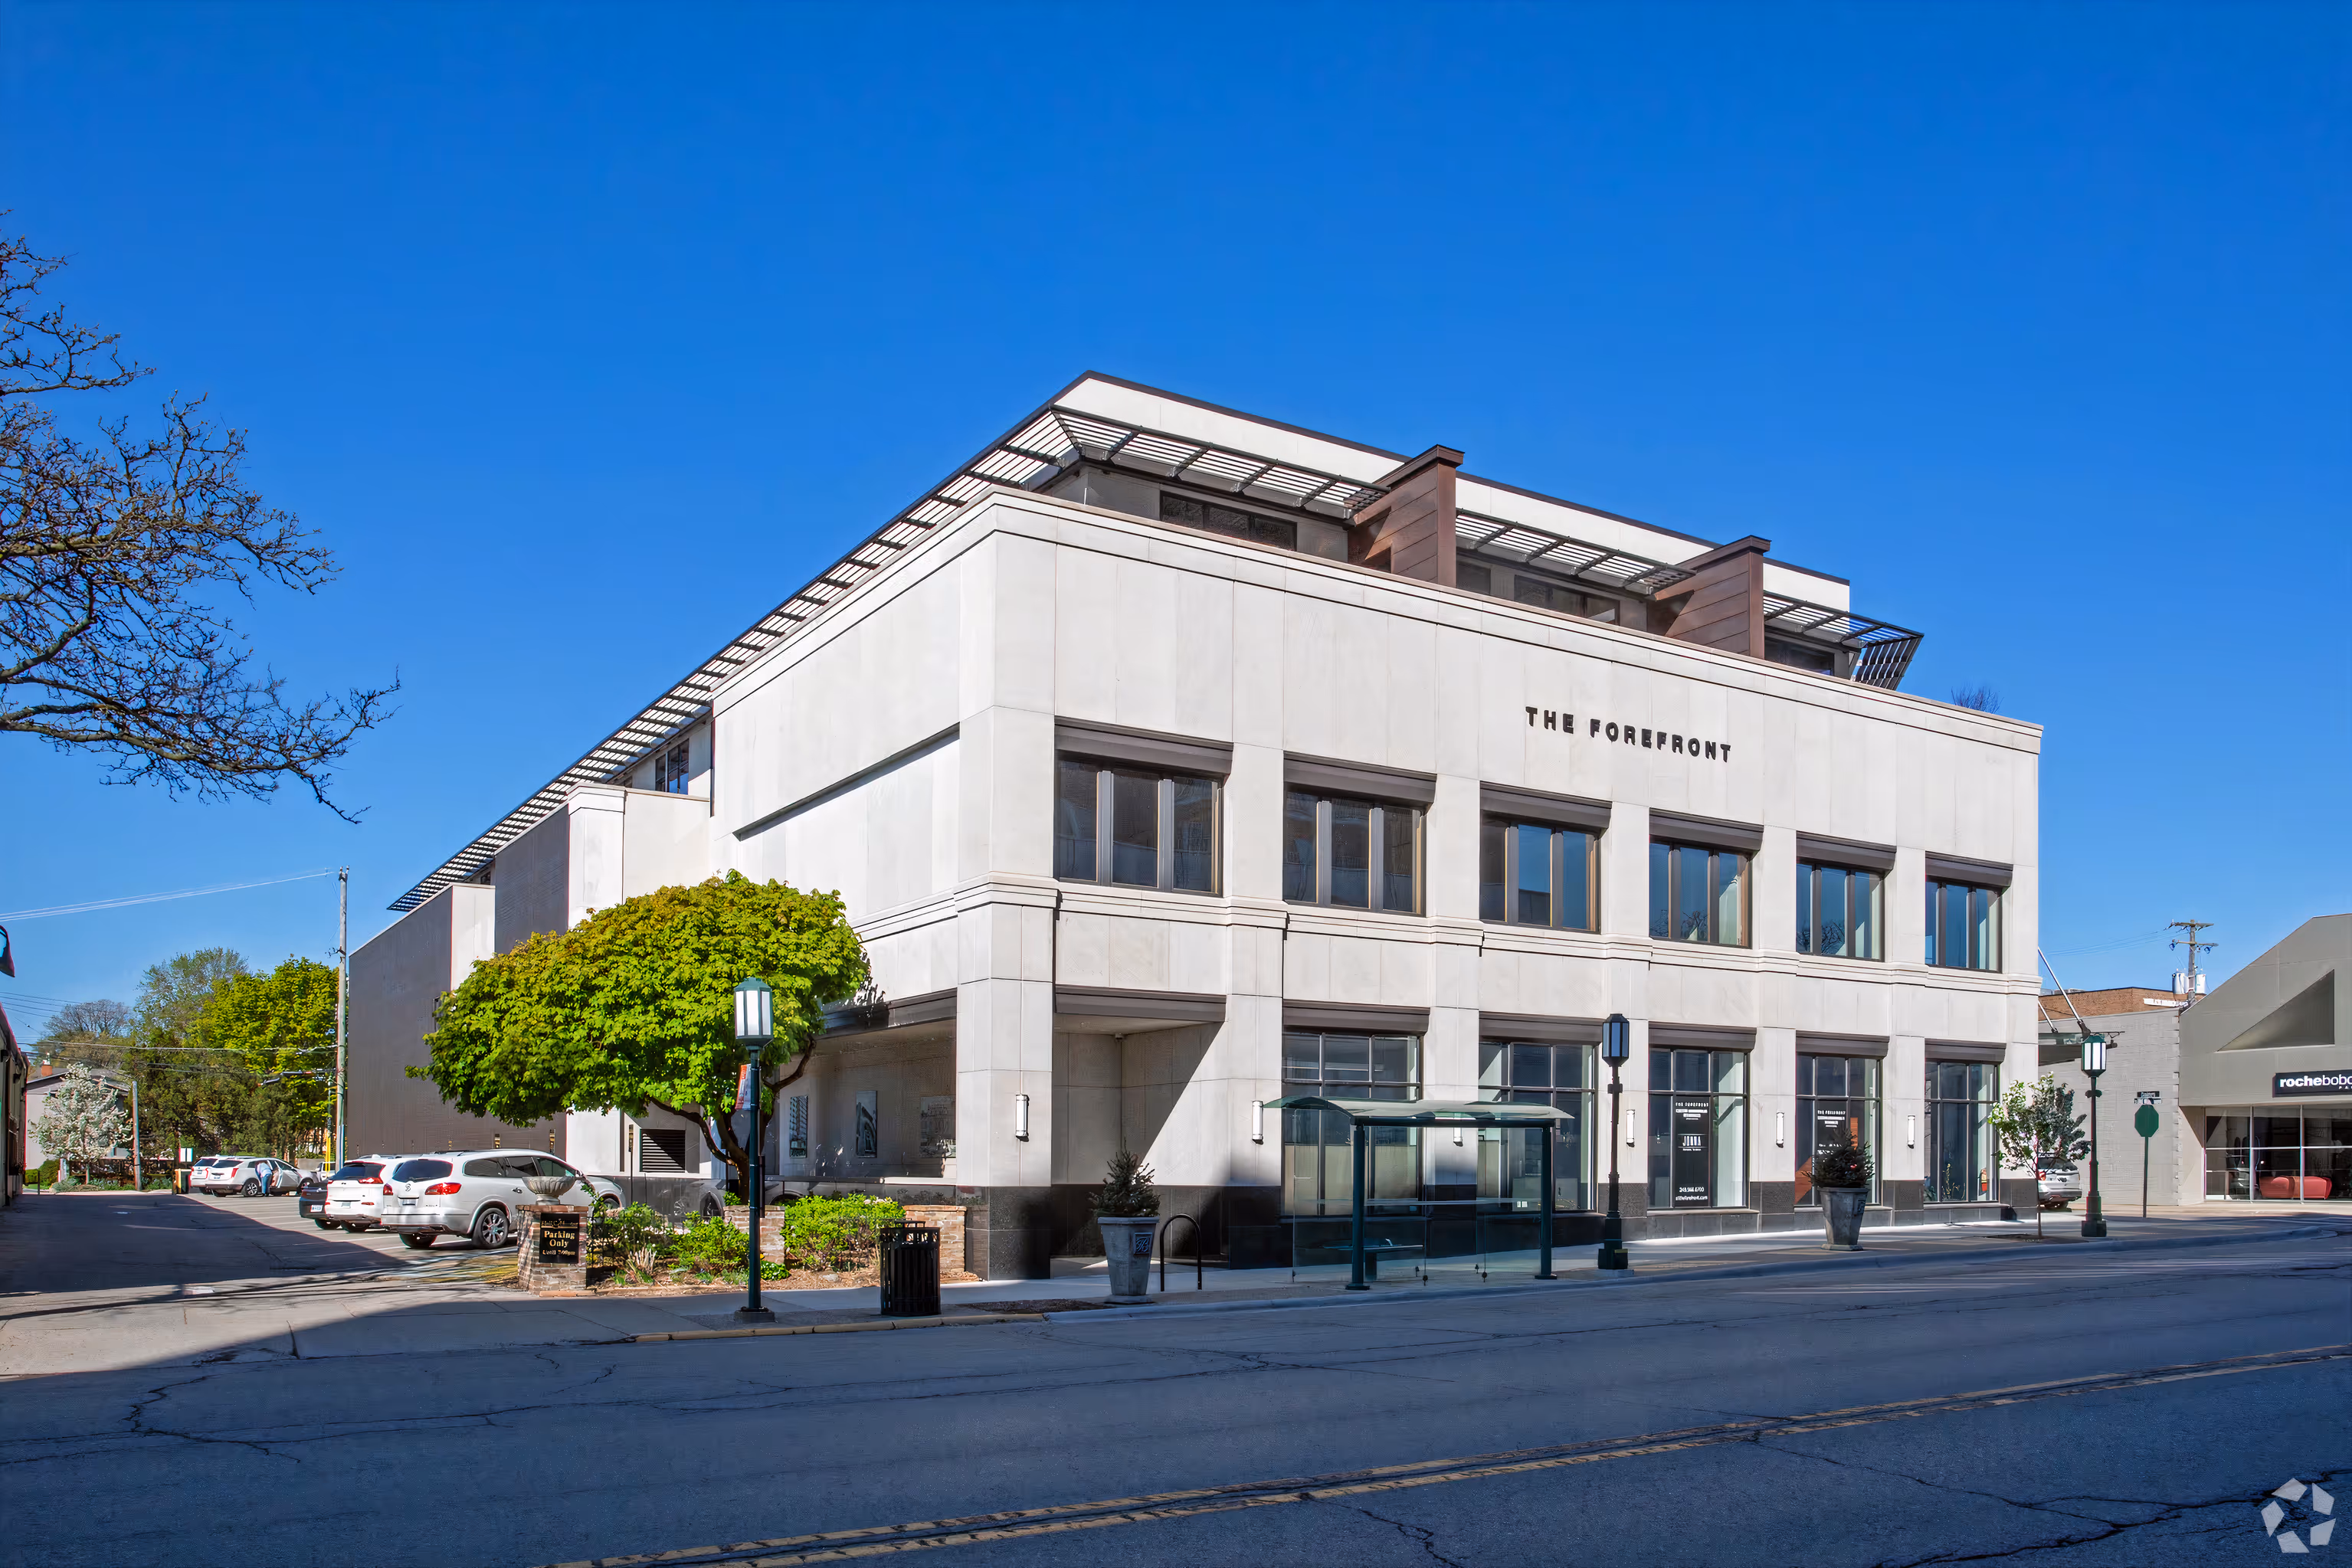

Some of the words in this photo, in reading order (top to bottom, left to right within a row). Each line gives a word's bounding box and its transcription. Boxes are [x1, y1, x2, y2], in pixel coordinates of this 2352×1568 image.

[1525, 705, 1574, 734] THE
[1590, 718, 1731, 763] FOREFRONT
[544, 1230, 575, 1239] Parking
[549, 1239, 568, 1248] Only
